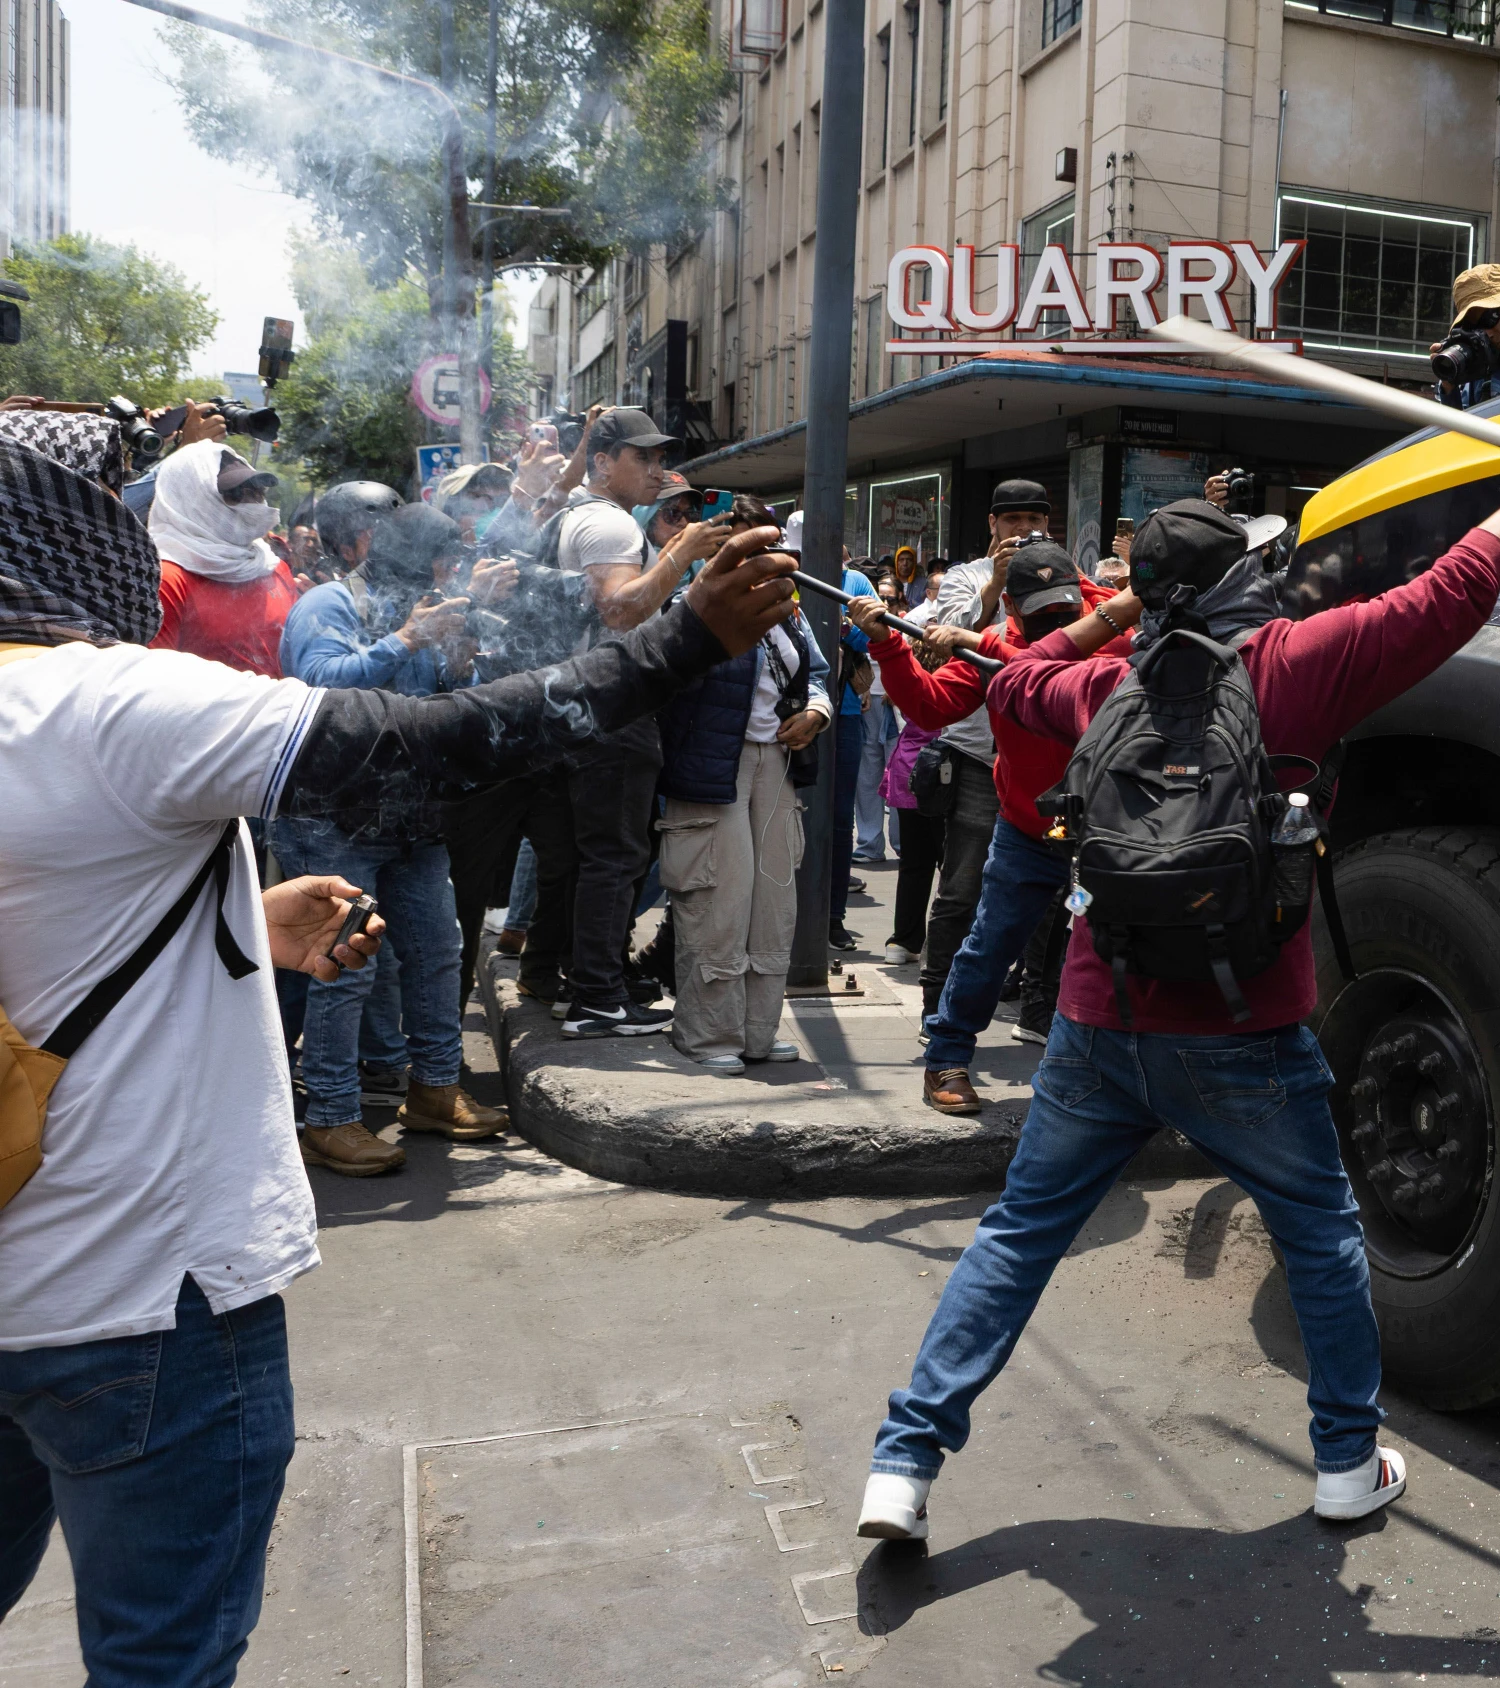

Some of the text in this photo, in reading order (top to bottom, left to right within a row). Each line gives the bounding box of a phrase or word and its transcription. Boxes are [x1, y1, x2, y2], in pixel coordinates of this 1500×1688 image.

[887, 240, 1308, 333] QUARRY
[1124, 420, 1174, 434] 20 DE NOVIEMBRE
